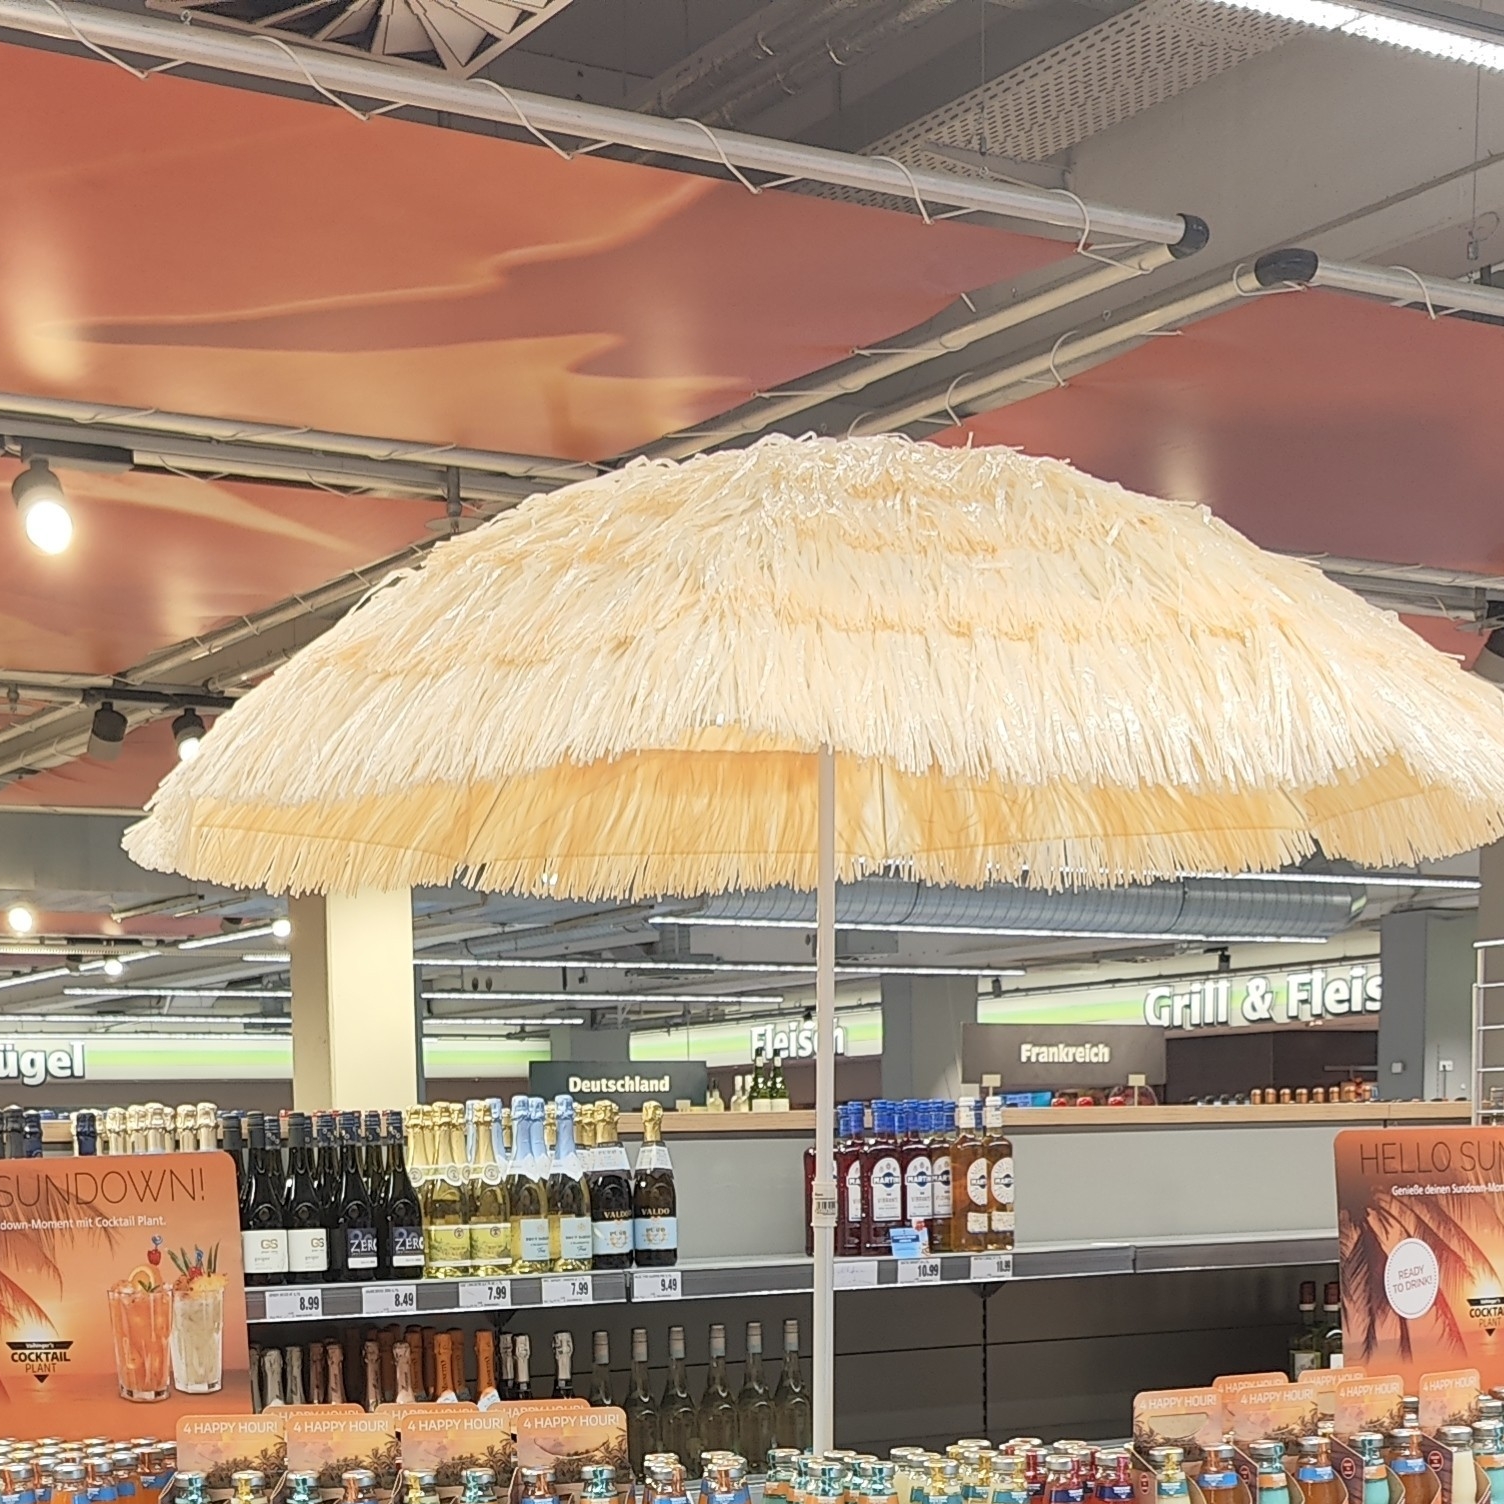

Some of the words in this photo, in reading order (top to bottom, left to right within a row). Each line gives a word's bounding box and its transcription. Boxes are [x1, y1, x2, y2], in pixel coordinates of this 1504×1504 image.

[1143, 977, 1230, 1028] Grill
[1241, 976, 1273, 1021] &
[750, 1020, 846, 1060] Fleish
[1020, 1043, 1111, 1063] Frankreich
[568, 1076, 670, 1094] Deutschland
[1359, 1140, 1452, 1175] HELLO
[1460, 1139, 1504, 1173] SU
[1391, 1184, 1424, 1196] Genieße
[1425, 1185, 1451, 1195] deinen
[641, 1207, 670, 1216] VALDO
[75, 1217, 94, 1229] mit
[96, 1215, 135, 1229] Cocktail
[137, 1214, 167, 1227] Plant.
[260, 1238, 279, 1250] GS
[917, 1264, 939, 1278] 10.99
[1398, 1265, 1425, 1280] READY
[571, 1281, 589, 1296] 7.99
[660, 1278, 678, 1292] 9.49
[1392, 1283, 1403, 1294] TO
[1405, 1275, 1433, 1292] DRINK!
[394, 1292, 414, 1307] 8.49
[487, 1285, 507, 1300] 7.99
[299, 1295, 320, 1311] 8.99
[1479, 1316, 1502, 1328] PLANT
[10, 1350, 72, 1363] COCKTAIL
[25, 1362, 57, 1375] PLANT
[1148, 1396, 1183, 1410] HAPPY
[1185, 1393, 1217, 1408] HOUR!
[1248, 1391, 1280, 1405] HAPPY
[1283, 1388, 1314, 1402] HOUR!
[194, 1423, 237, 1434] HAPPY
[240, 1421, 278, 1433] HOUR!
[304, 1421, 347, 1433] HAPPY
[349, 1420, 389, 1432] HOUR!
[418, 1419, 461, 1432] HAPPY
[463, 1418, 504, 1430] HOUR!
[534, 1417, 577, 1429] HAPPY
[579, 1414, 620, 1427] HOUR!
